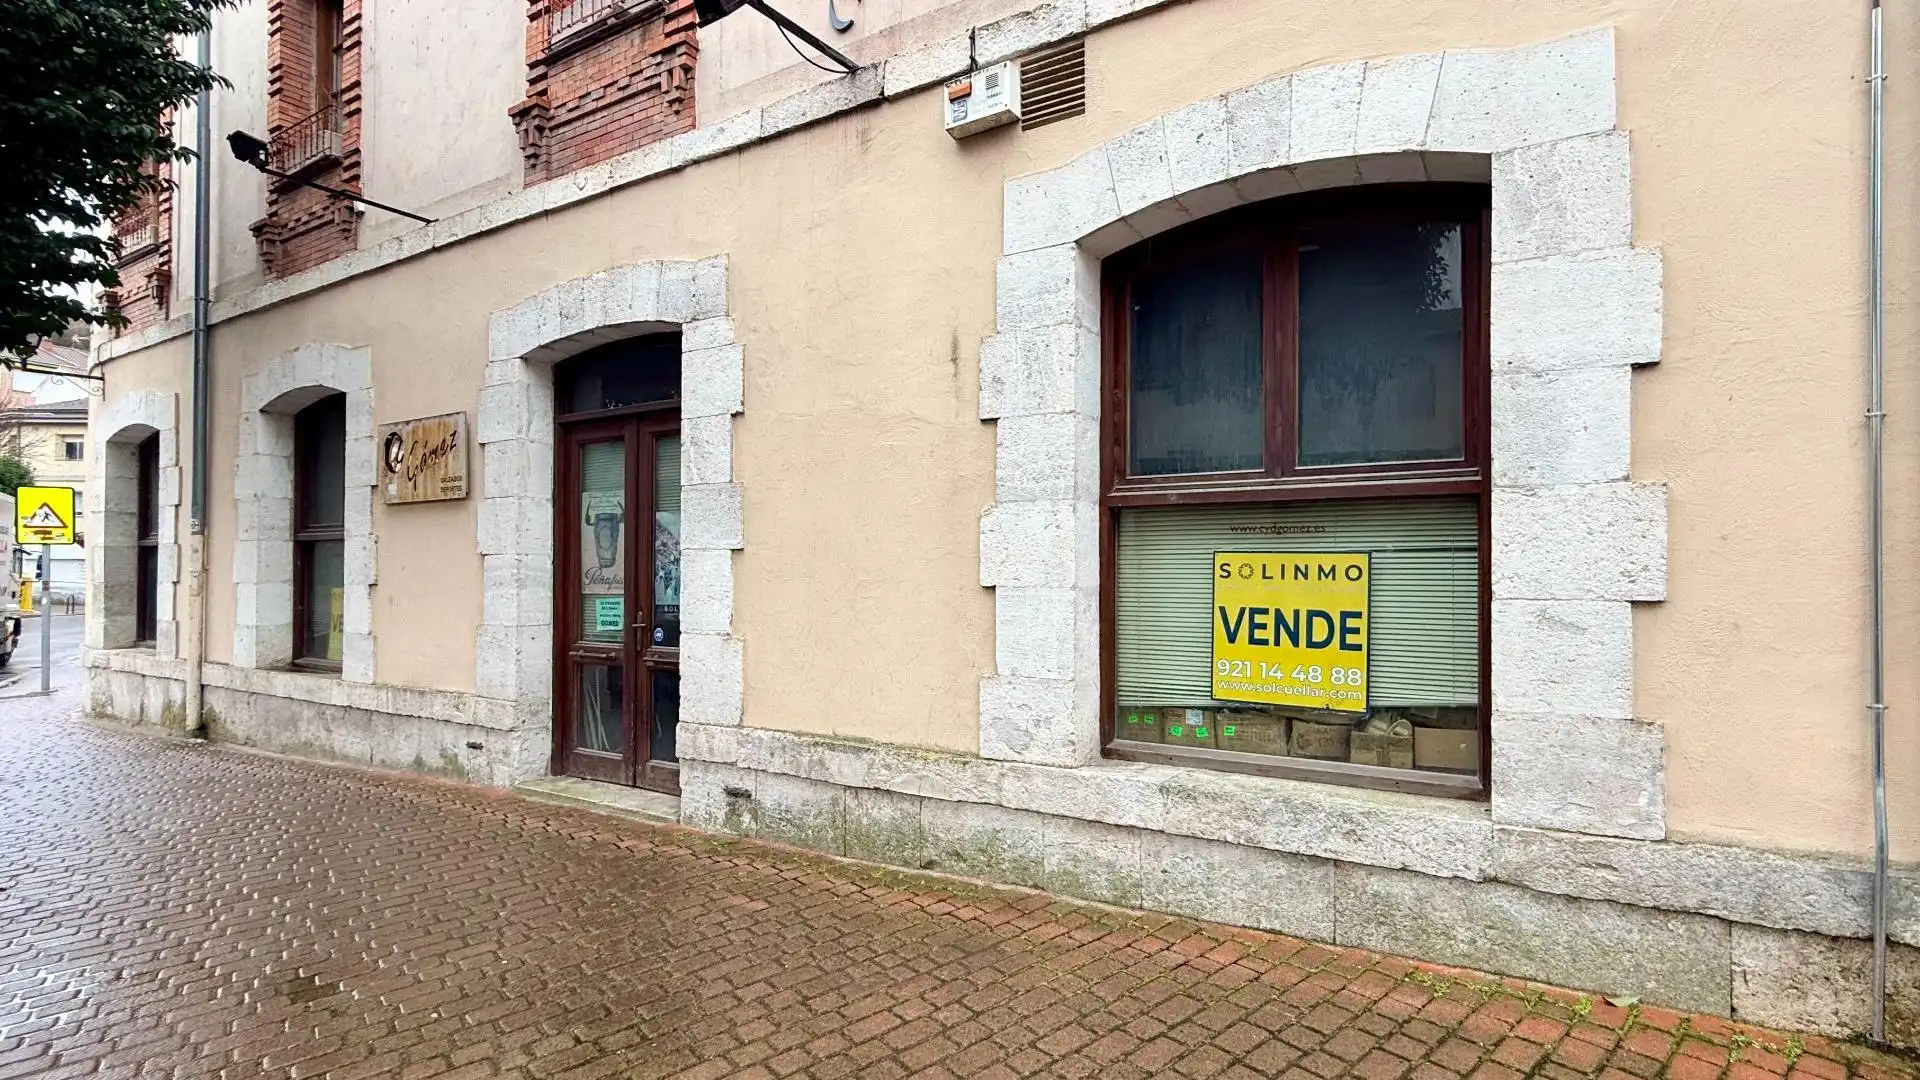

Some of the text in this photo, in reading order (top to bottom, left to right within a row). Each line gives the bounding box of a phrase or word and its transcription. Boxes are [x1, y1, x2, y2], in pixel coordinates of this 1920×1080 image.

[1230, 522, 1326, 535] www.cydgomez.es
[1219, 562, 1363, 582] SOLINMO
[1218, 606, 1363, 651] VENDE
[1217, 659, 1362, 686] 921 14 48 88
[1217, 680, 1362, 700] www.solcuellar.com
